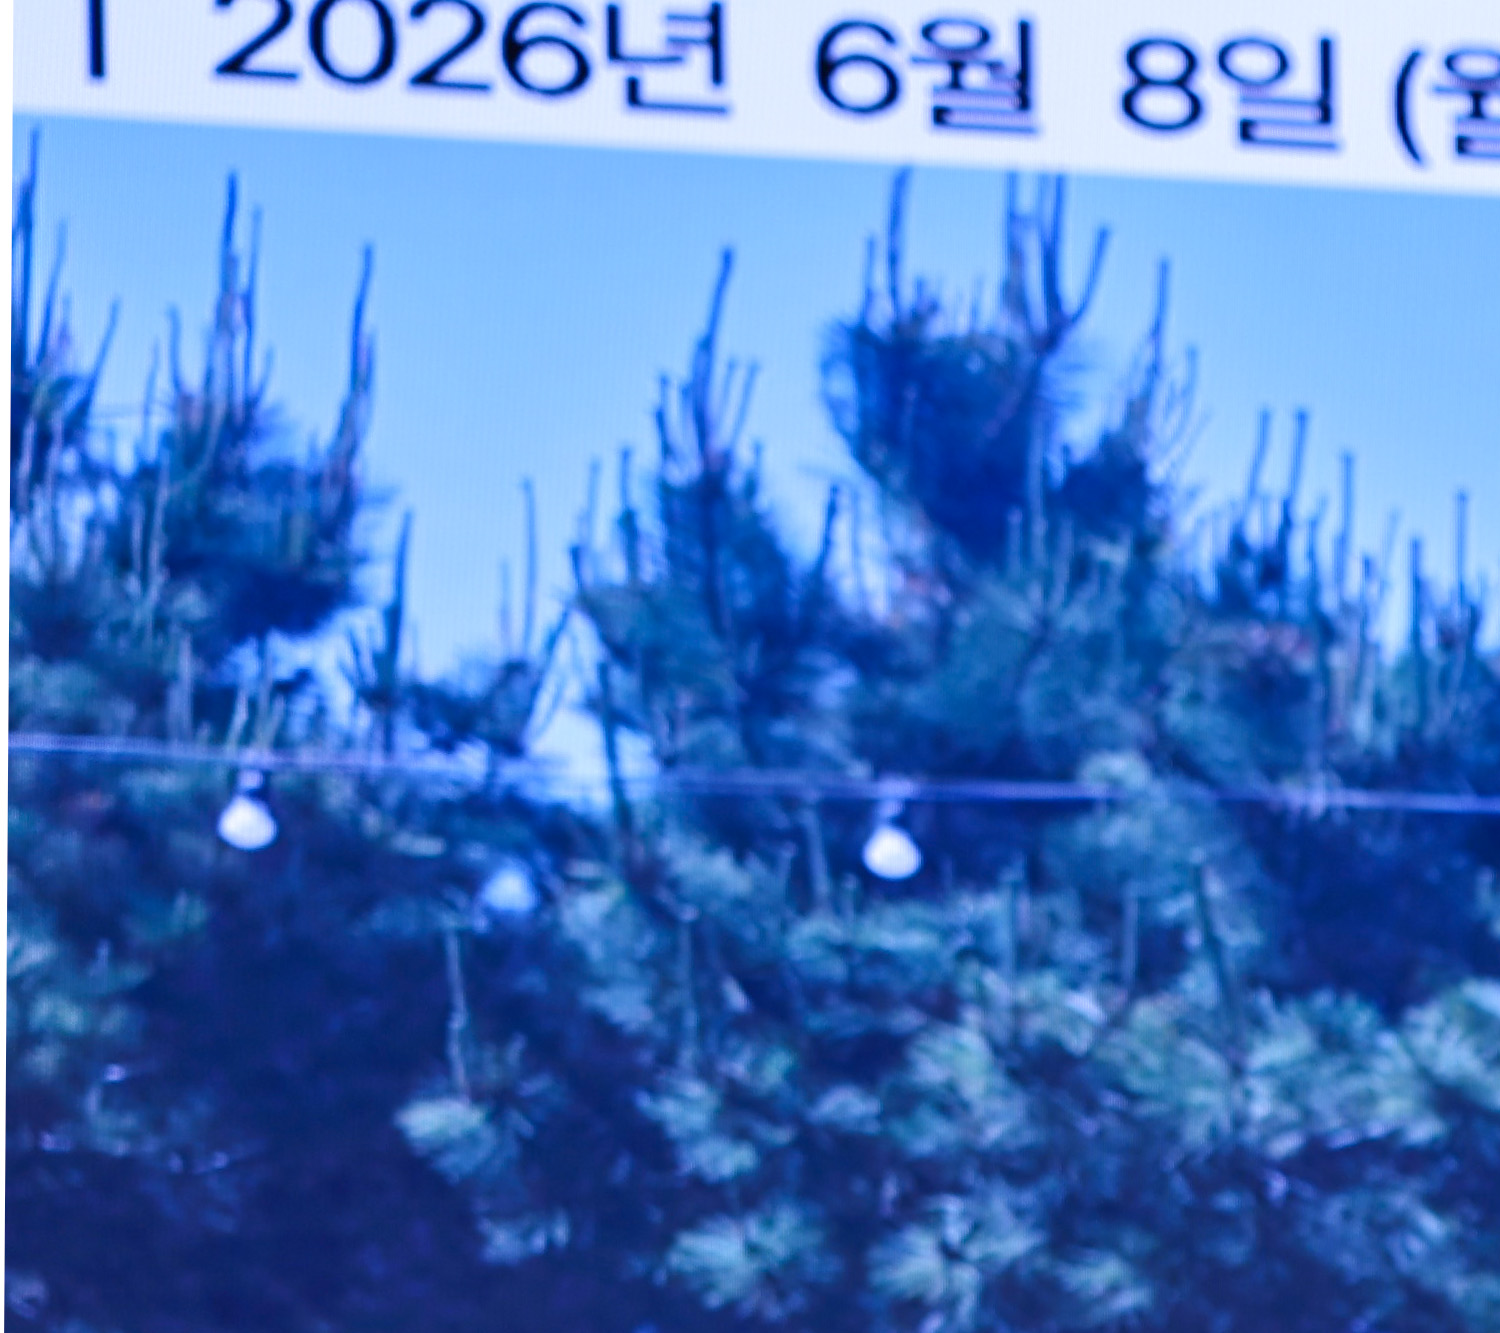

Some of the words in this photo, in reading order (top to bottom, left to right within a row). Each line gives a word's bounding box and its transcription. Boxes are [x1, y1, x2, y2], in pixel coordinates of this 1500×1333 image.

[208, 0, 734, 117] 2026년
[813, 17, 1041, 136] 6월
[1119, 36, 1342, 151] 8일
